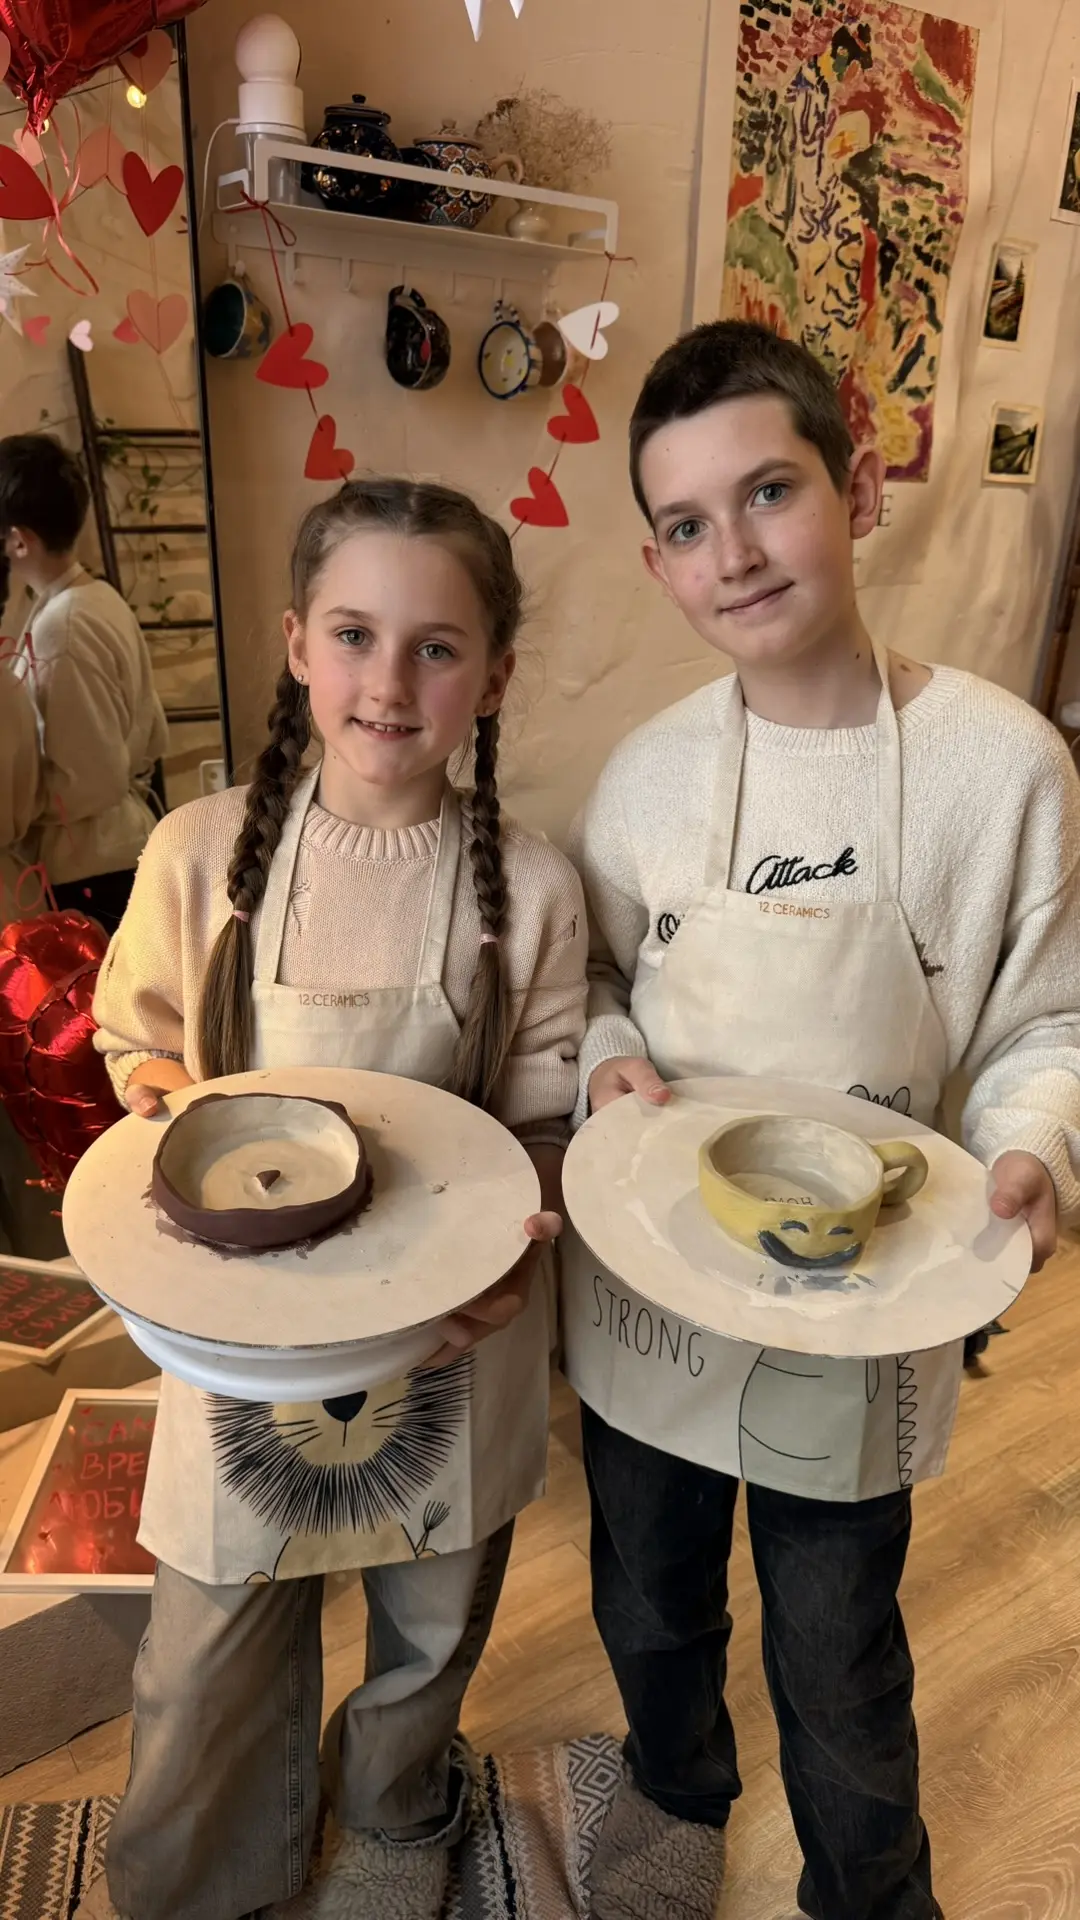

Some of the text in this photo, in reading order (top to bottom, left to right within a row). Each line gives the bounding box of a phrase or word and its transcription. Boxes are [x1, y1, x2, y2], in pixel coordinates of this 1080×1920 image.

[745, 847, 859, 895] Attack
[758, 901, 830, 919] 12 CERAMICS
[298, 992, 370, 1008] 12 CERAMICS
[593, 1275, 704, 1377] STRONG
